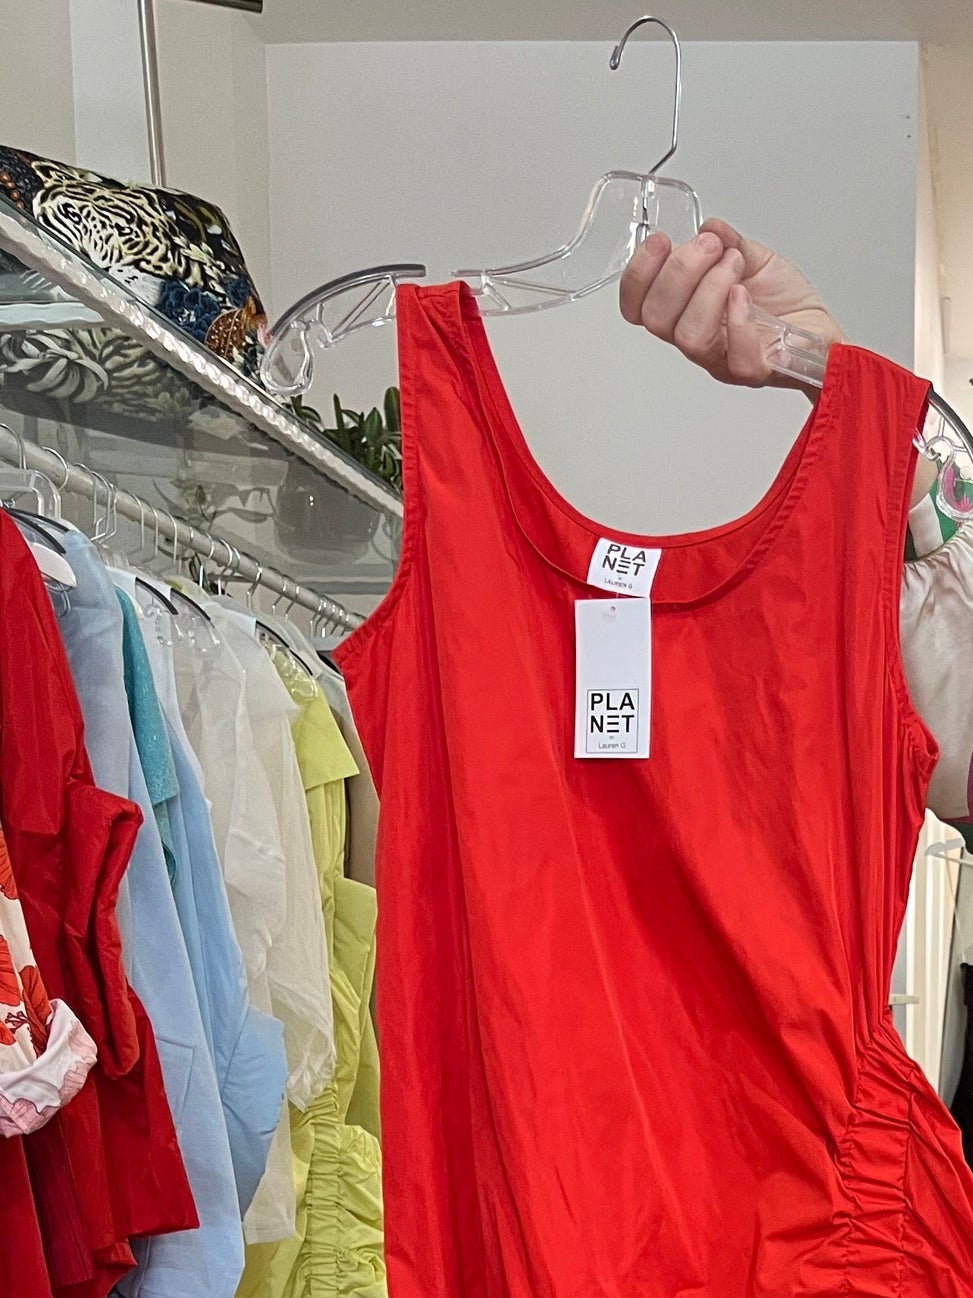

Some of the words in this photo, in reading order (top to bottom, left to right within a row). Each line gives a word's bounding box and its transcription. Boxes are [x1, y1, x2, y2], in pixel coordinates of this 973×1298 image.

[607, 543, 647, 563] PLA
[602, 555, 645, 576] NET
[590, 692, 635, 711] PLA
[590, 714, 635, 733] NET
